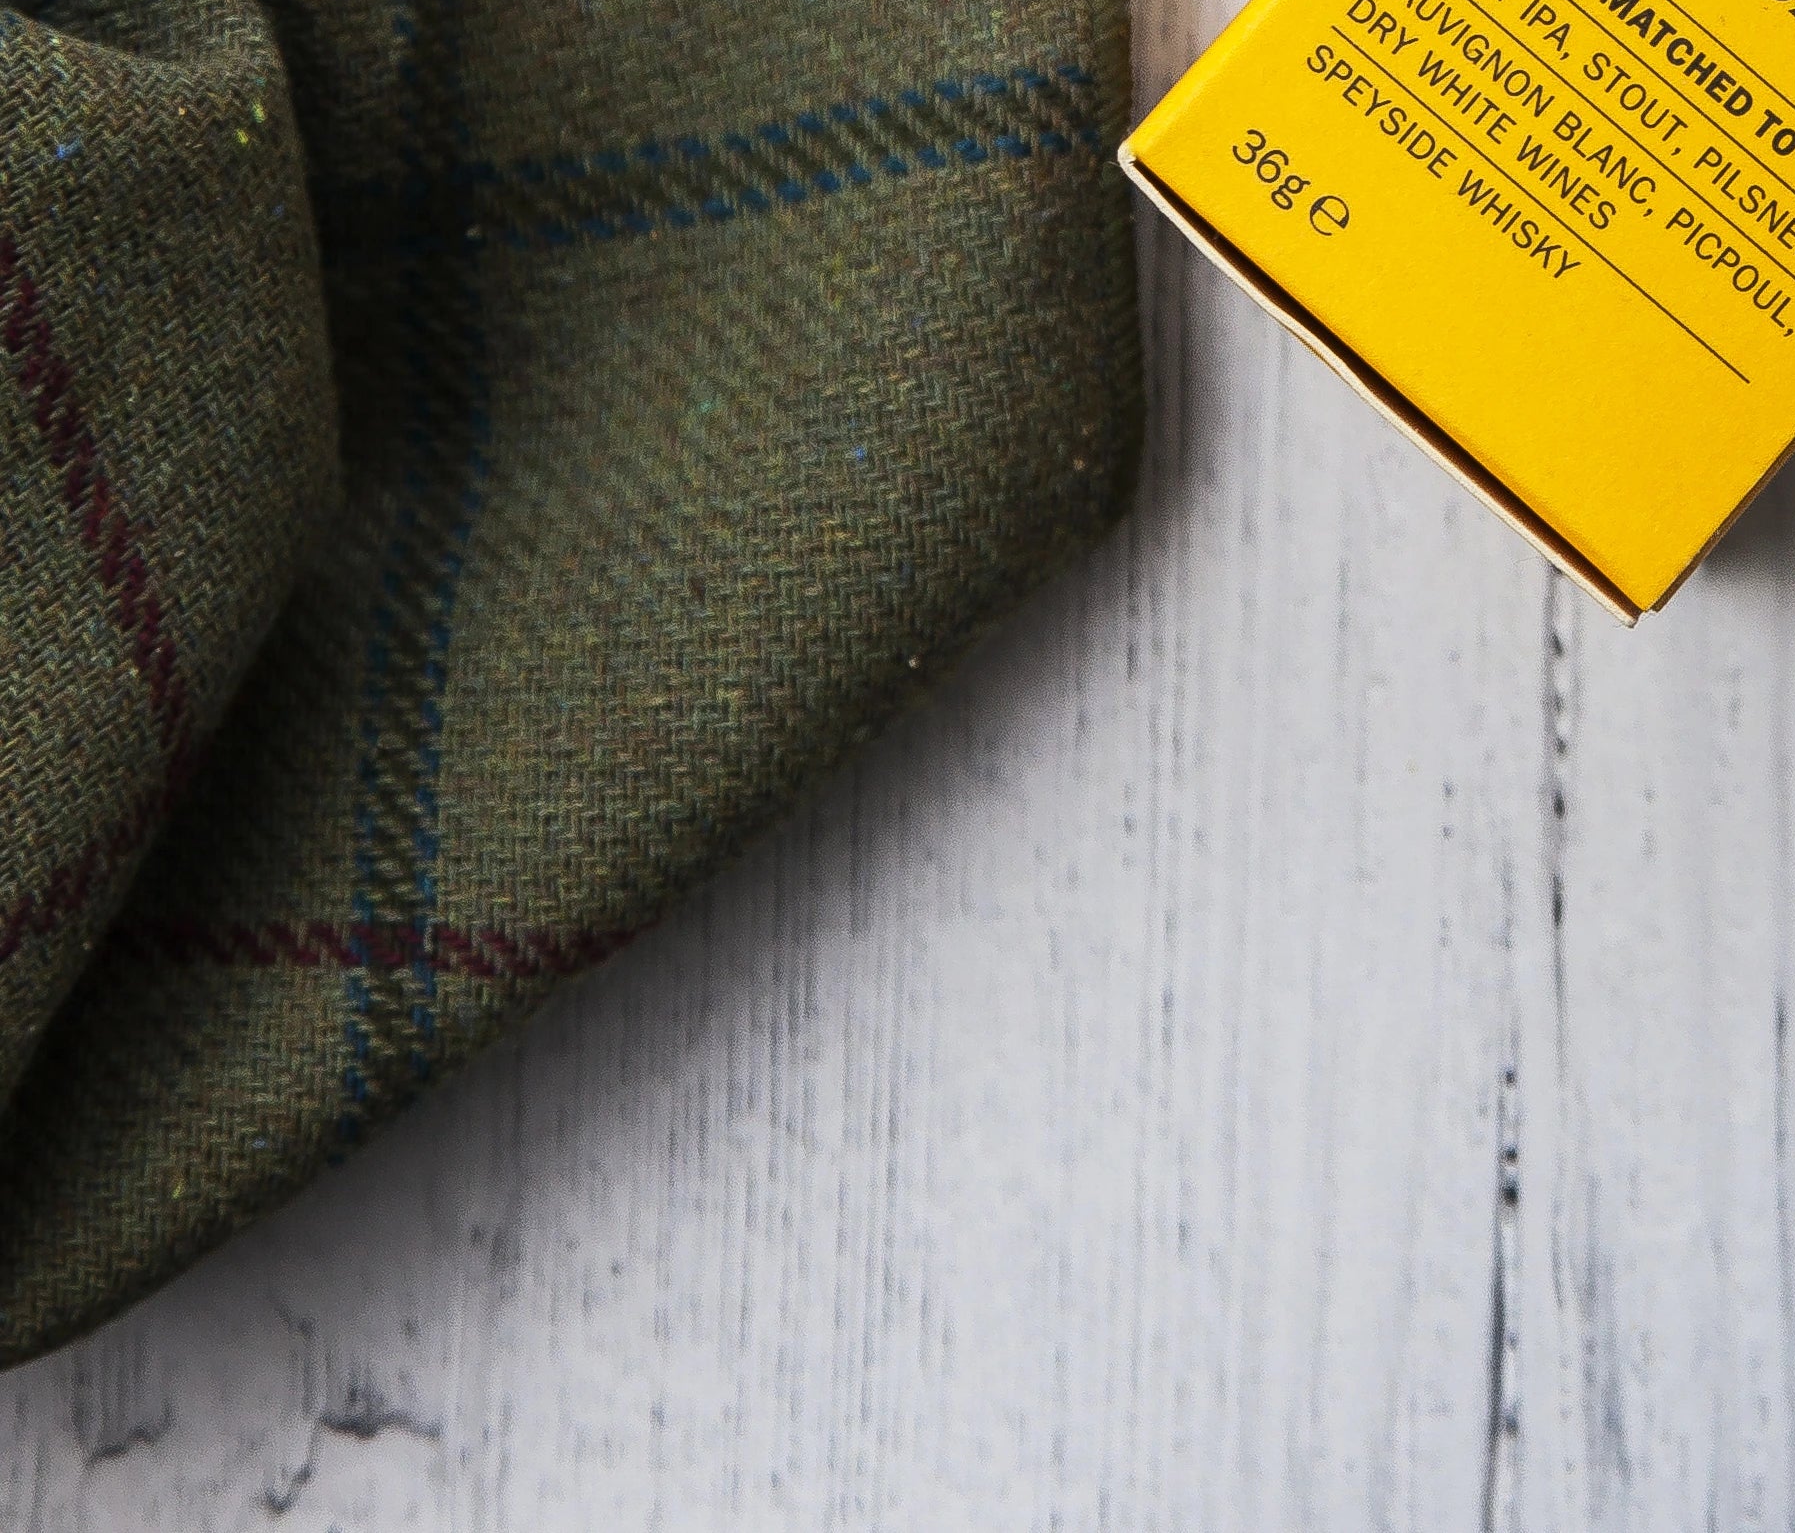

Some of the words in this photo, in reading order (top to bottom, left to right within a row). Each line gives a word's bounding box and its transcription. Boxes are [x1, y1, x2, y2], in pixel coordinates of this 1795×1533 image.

[1233, 130, 1310, 210] 36g
[1307, 45, 1457, 178] SPEYSIDE
[1458, 170, 1581, 278] WHISKY
[1418, 51, 1516, 144] WHITE
[1517, 135, 1616, 229] WINES
[1584, 53, 1688, 155] STOUT,
[1553, 111, 1655, 216] BLANC,
[1666, 208, 1793, 336] PICPOUL,
